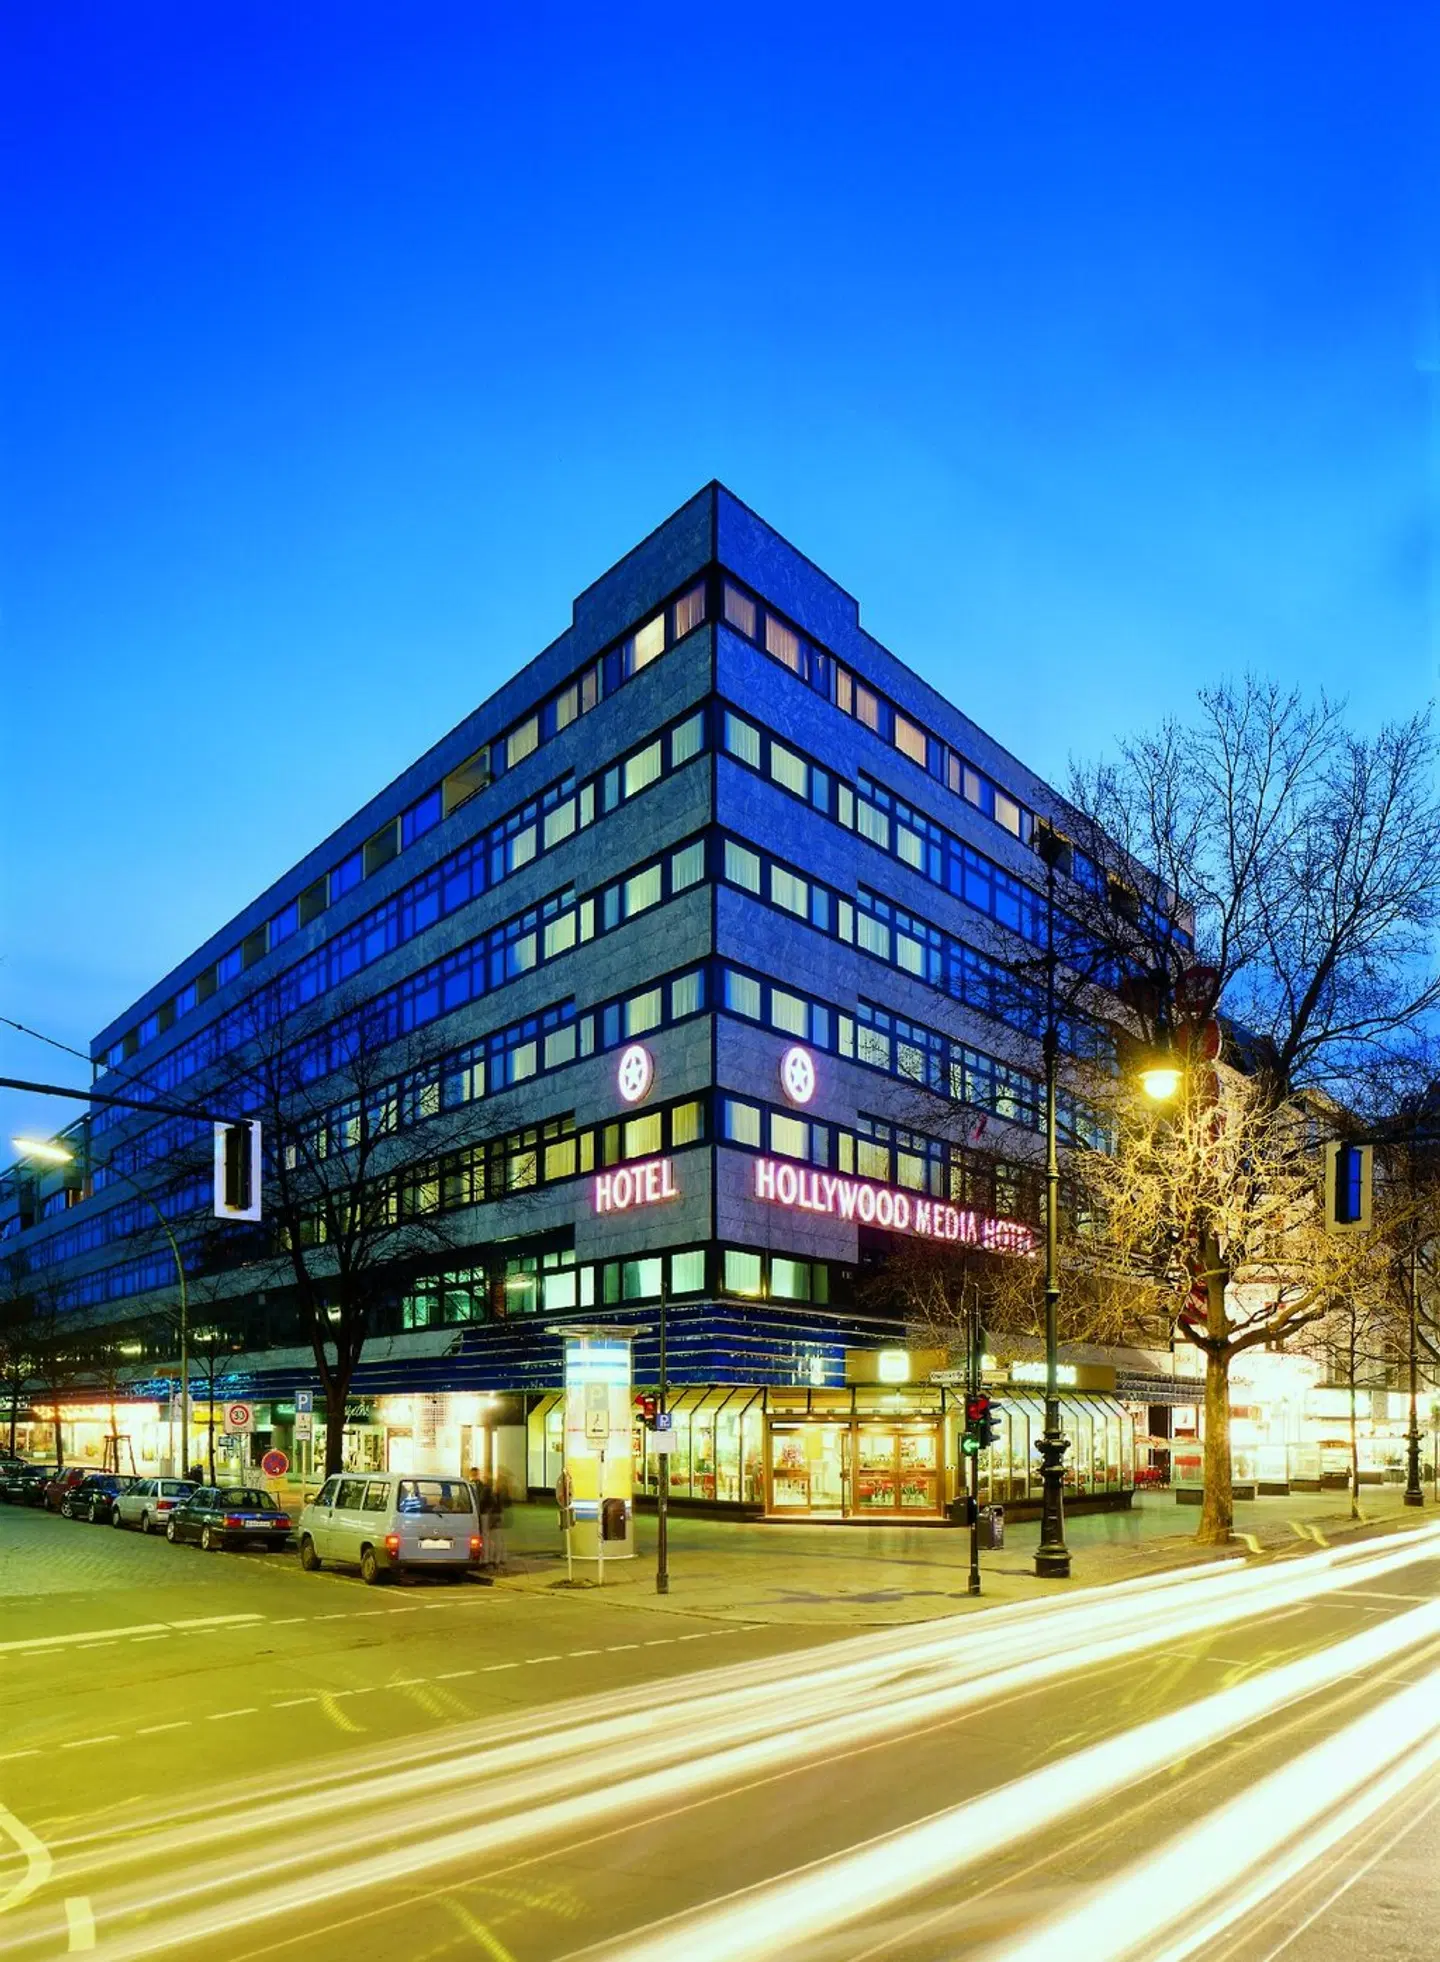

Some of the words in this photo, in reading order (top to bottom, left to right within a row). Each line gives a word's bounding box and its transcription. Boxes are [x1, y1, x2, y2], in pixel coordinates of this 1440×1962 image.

[595, 1159, 677, 1213] HOTEL
[755, 1158, 910, 1230] HOLLYWOOD
[915, 1200, 977, 1243] MEDIA
[982, 1218, 1036, 1258] HOTEL
[233, 1411, 245, 1421] 30
[298, 1393, 308, 1410] P
